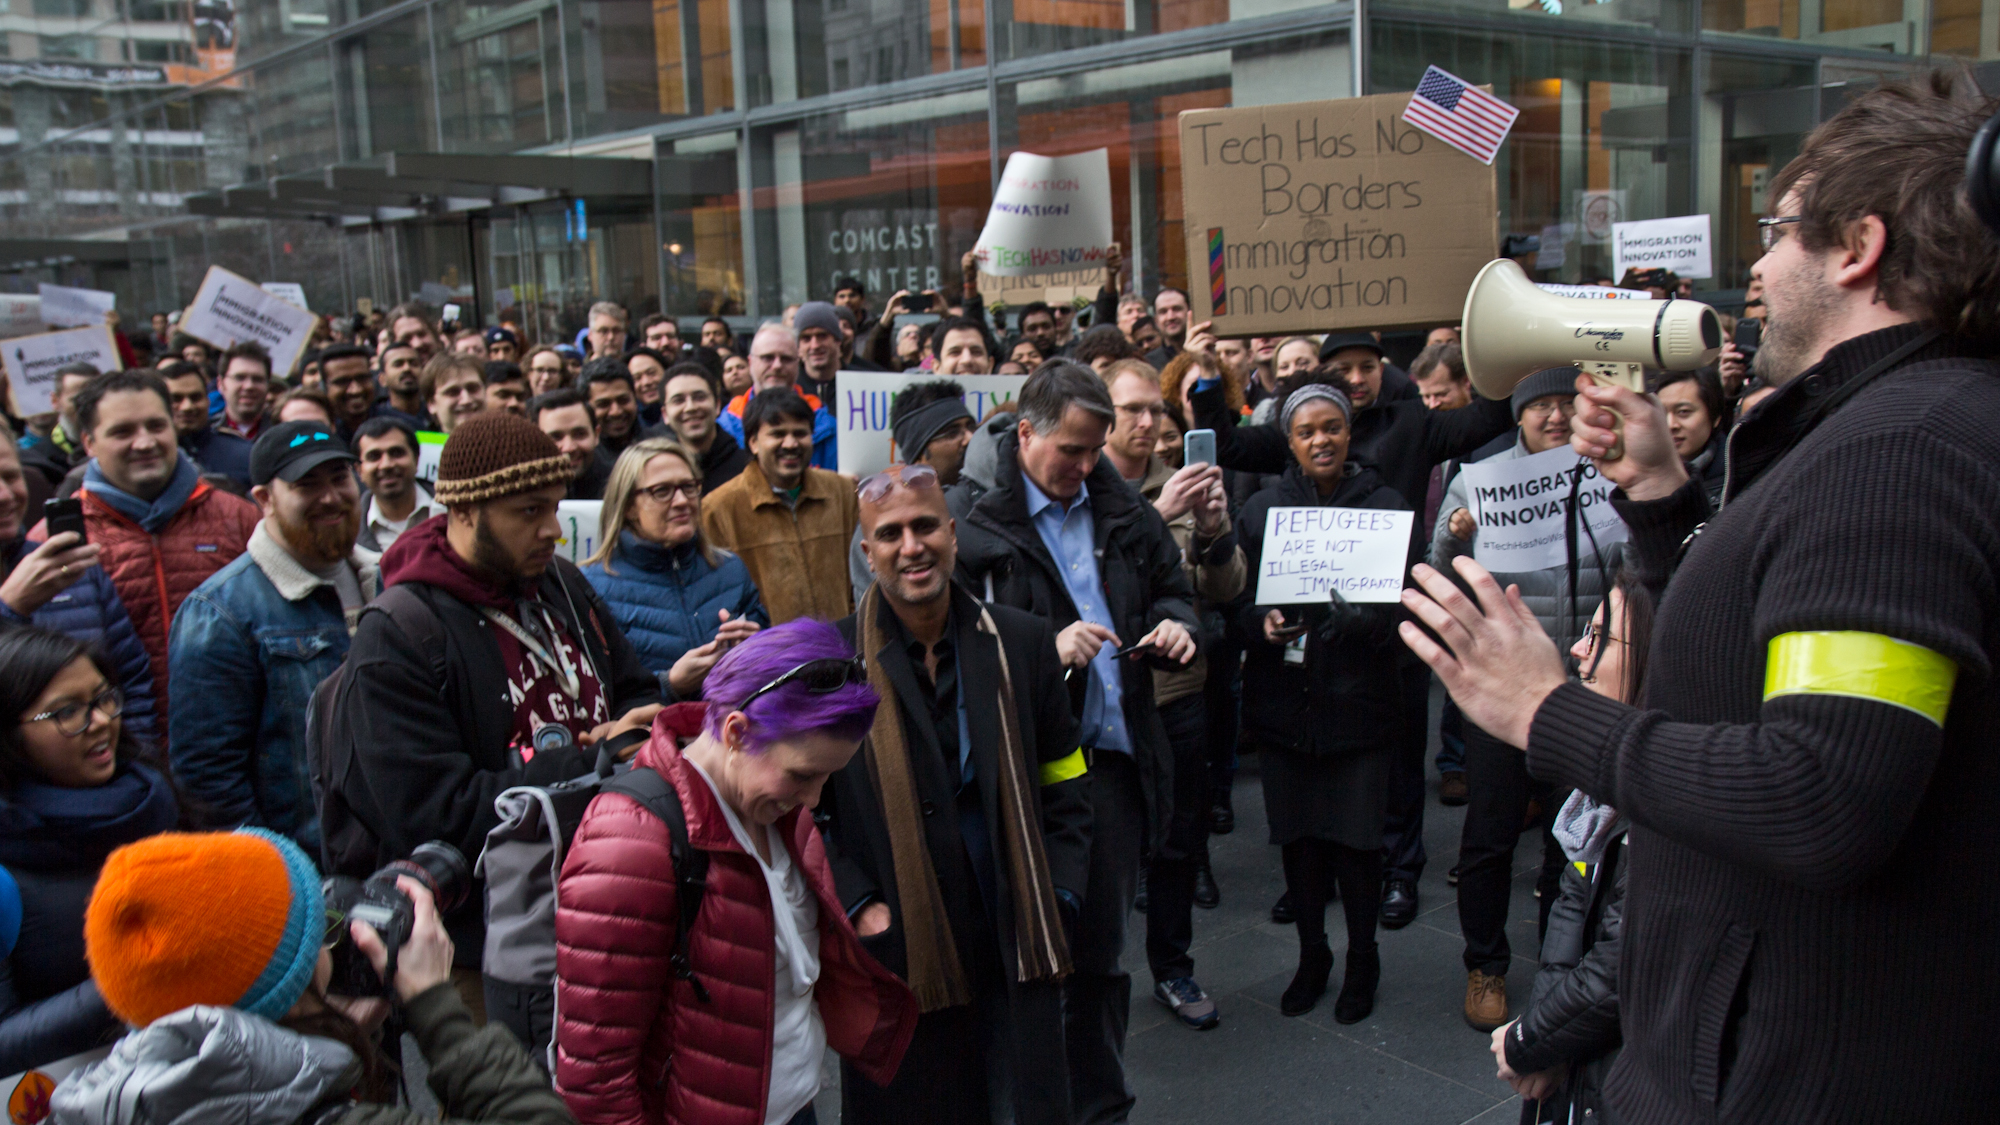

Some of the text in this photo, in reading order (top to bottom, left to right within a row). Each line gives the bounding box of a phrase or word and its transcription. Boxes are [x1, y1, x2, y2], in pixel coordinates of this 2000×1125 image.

[1190, 114, 1424, 166] Tech Has No
[1261, 163, 1422, 216] Borders
[829, 223, 937, 253] COMCAST
[1207, 223, 1406, 280] Immigration
[1619, 234, 1703, 250] IMMIGRATION
[1620, 248, 1697, 263] INNOVATION
[1209, 268, 1407, 317] Innovation
[210, 288, 292, 336] IMMIGRATION
[210, 302, 282, 344] INNOVATION
[1595, 341, 1610, 351] CE
[1476, 463, 1599, 504] IMMIGRATO
[1274, 509, 1396, 536] REFUGEES
[1477, 486, 1608, 527] INNOVATON
[1281, 539, 1362, 556] ARE NOT
[1483, 533, 1565, 550] #TechHasNoWa
[1266, 559, 1344, 577] ILLEGAL
[1295, 577, 1401, 596] IMMIGRANTS
[528, 692, 606, 737] AGLE
